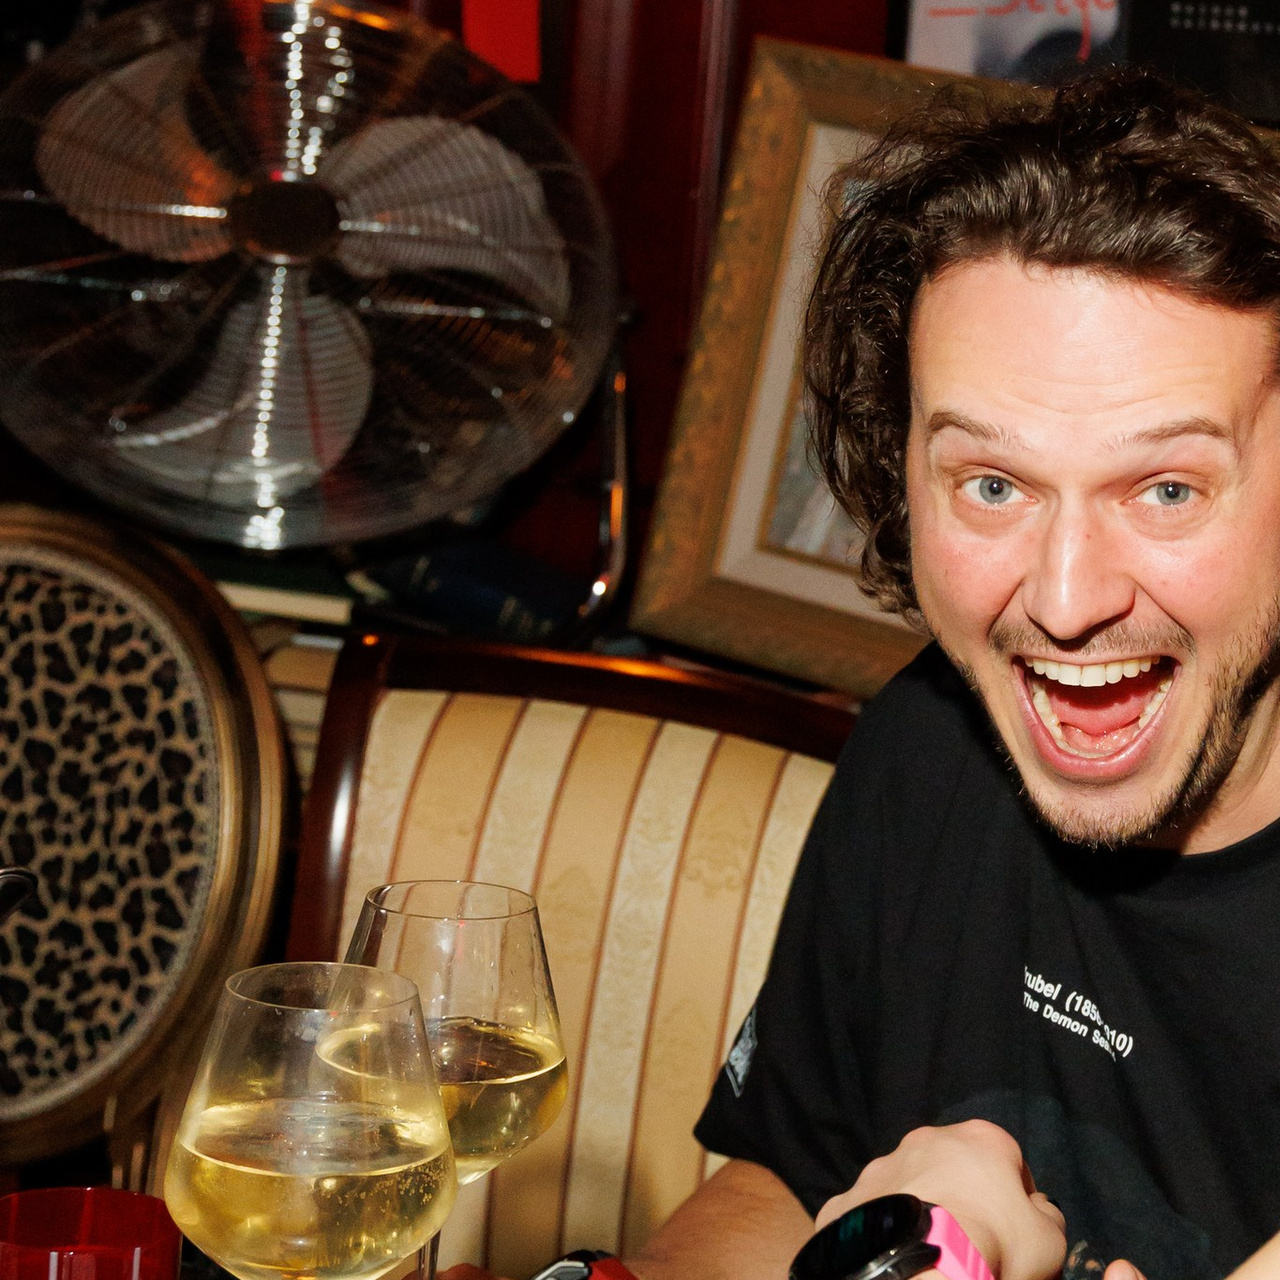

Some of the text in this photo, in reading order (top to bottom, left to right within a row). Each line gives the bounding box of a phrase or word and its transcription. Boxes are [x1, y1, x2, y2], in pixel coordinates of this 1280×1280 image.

[1024, 965, 1062, 1001] rubel
[1023, 991, 1040, 1013] The
[1042, 1003, 1089, 1038] Demon
